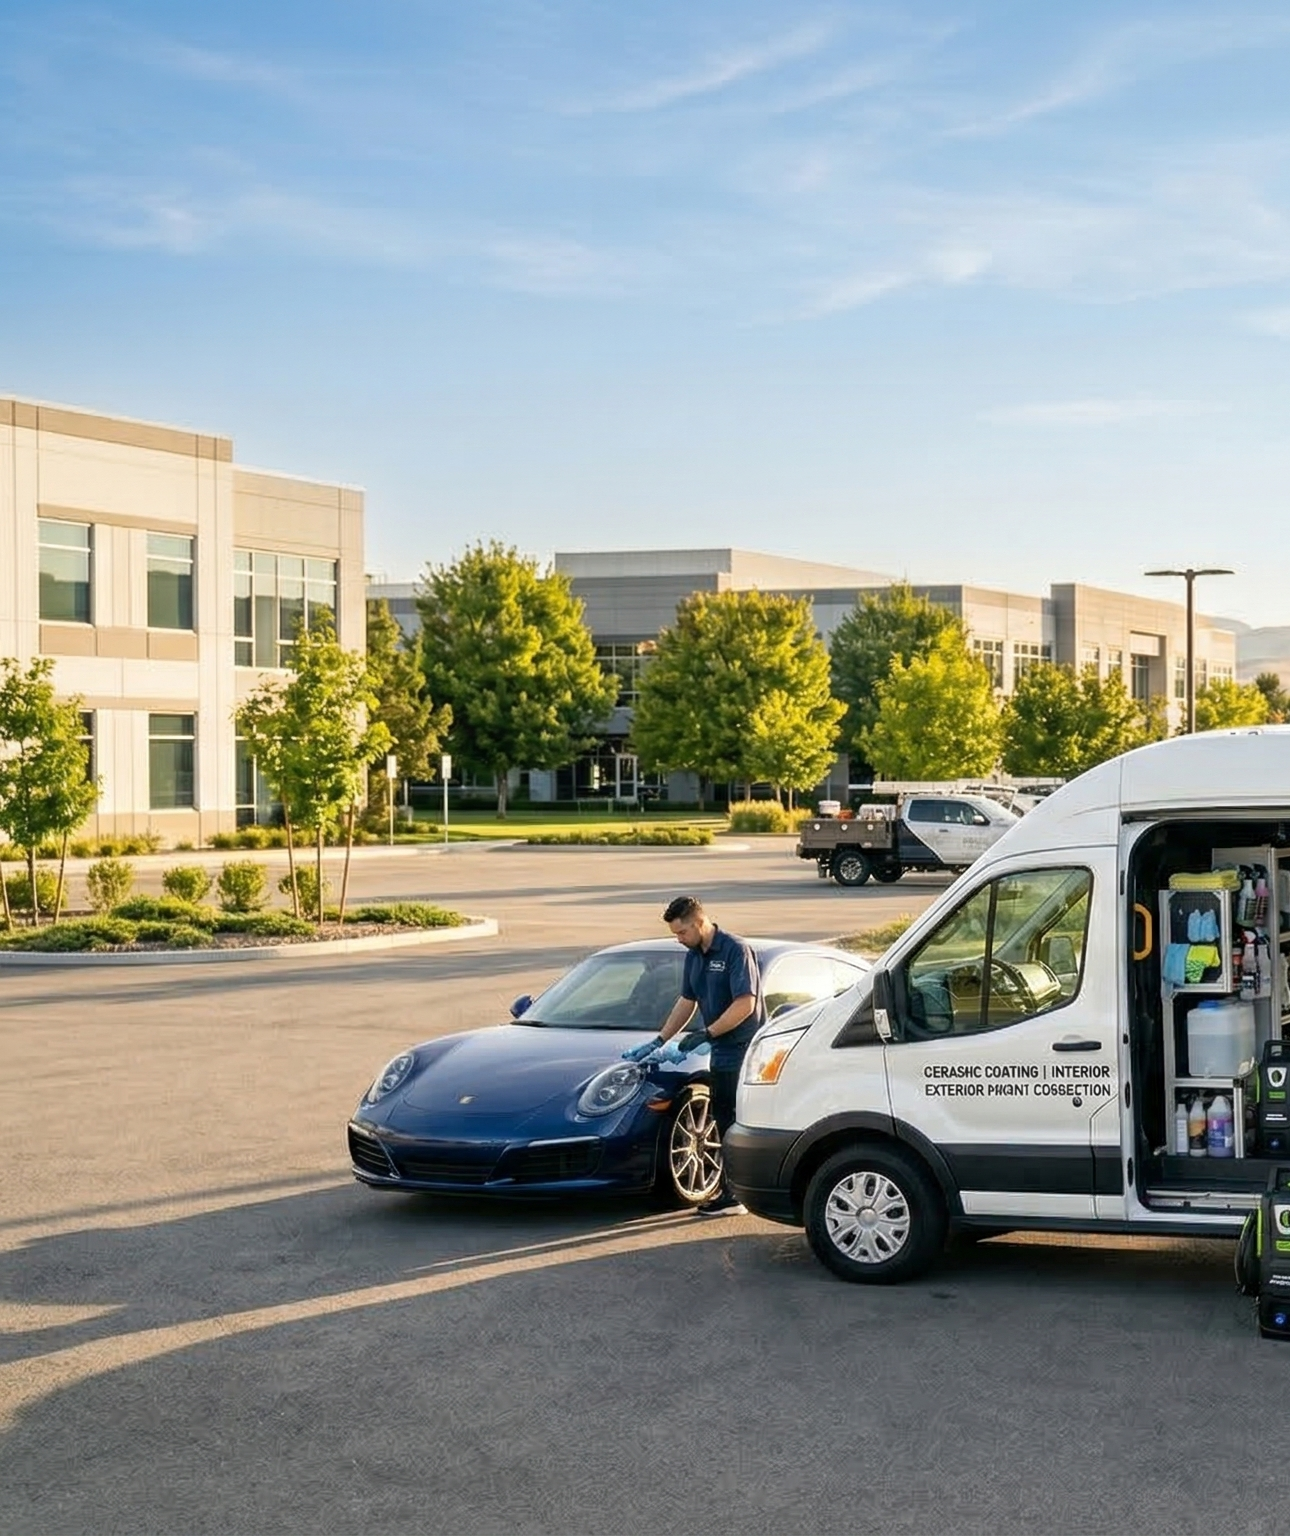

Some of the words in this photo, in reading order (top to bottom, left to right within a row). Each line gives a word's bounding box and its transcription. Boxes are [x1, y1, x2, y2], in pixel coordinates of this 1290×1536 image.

[984, 1065, 1039, 1079] COATING
[1051, 1065, 1111, 1079] INTERIOR
[925, 1083, 985, 1097] EXTERIOR
